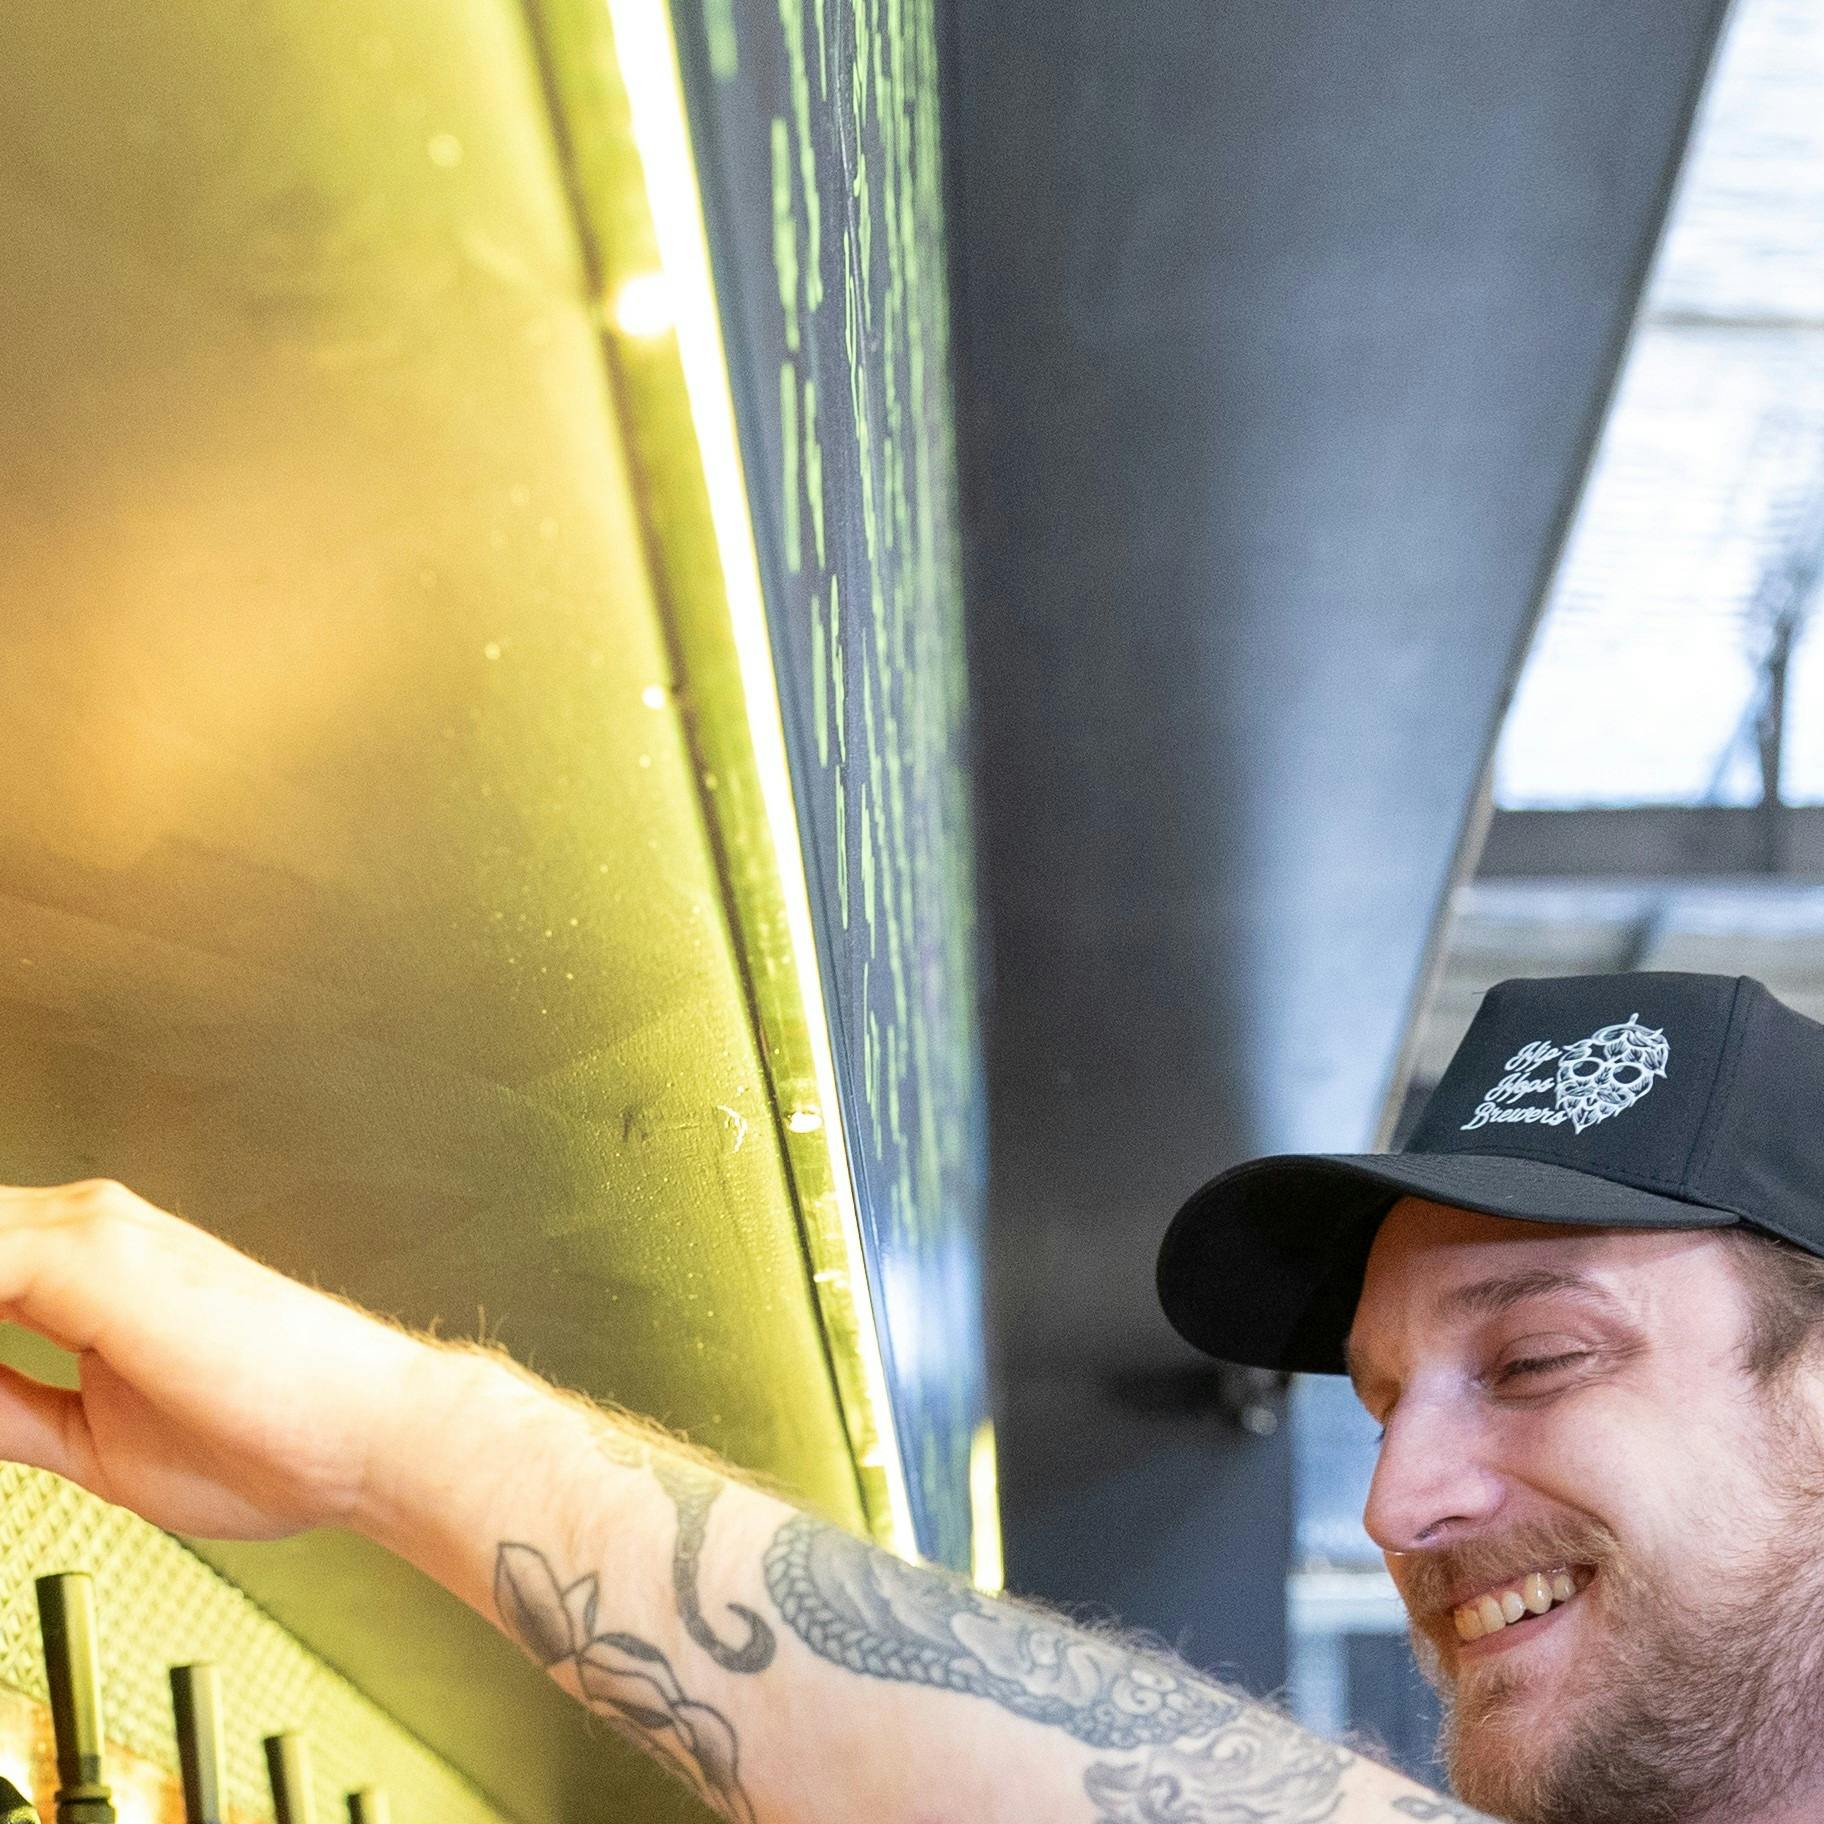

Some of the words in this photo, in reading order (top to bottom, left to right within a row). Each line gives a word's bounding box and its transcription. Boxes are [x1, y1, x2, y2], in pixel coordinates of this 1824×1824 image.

[1504, 1040, 1563, 1072] Hip
[1484, 1072, 1555, 1104] Hops
[1460, 1101, 1568, 1131] Brewers
